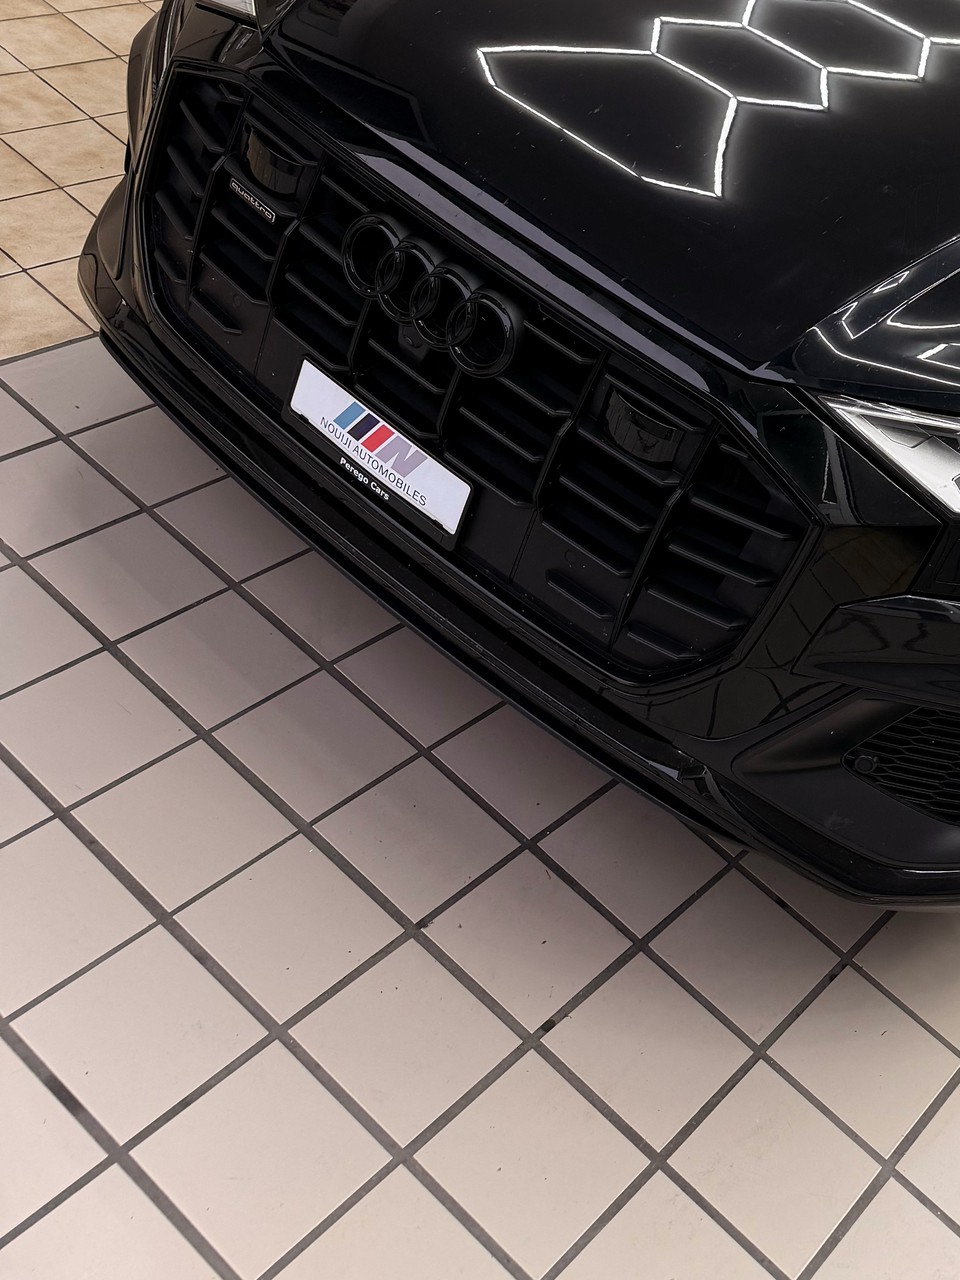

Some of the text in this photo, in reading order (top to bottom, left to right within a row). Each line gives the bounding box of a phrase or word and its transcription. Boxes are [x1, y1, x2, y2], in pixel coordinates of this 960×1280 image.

[231, 182, 272, 219] quattro
[320, 416, 427, 506] NOUIJI AUTOMOBILES
[339, 457, 390, 501] Perego Cars
